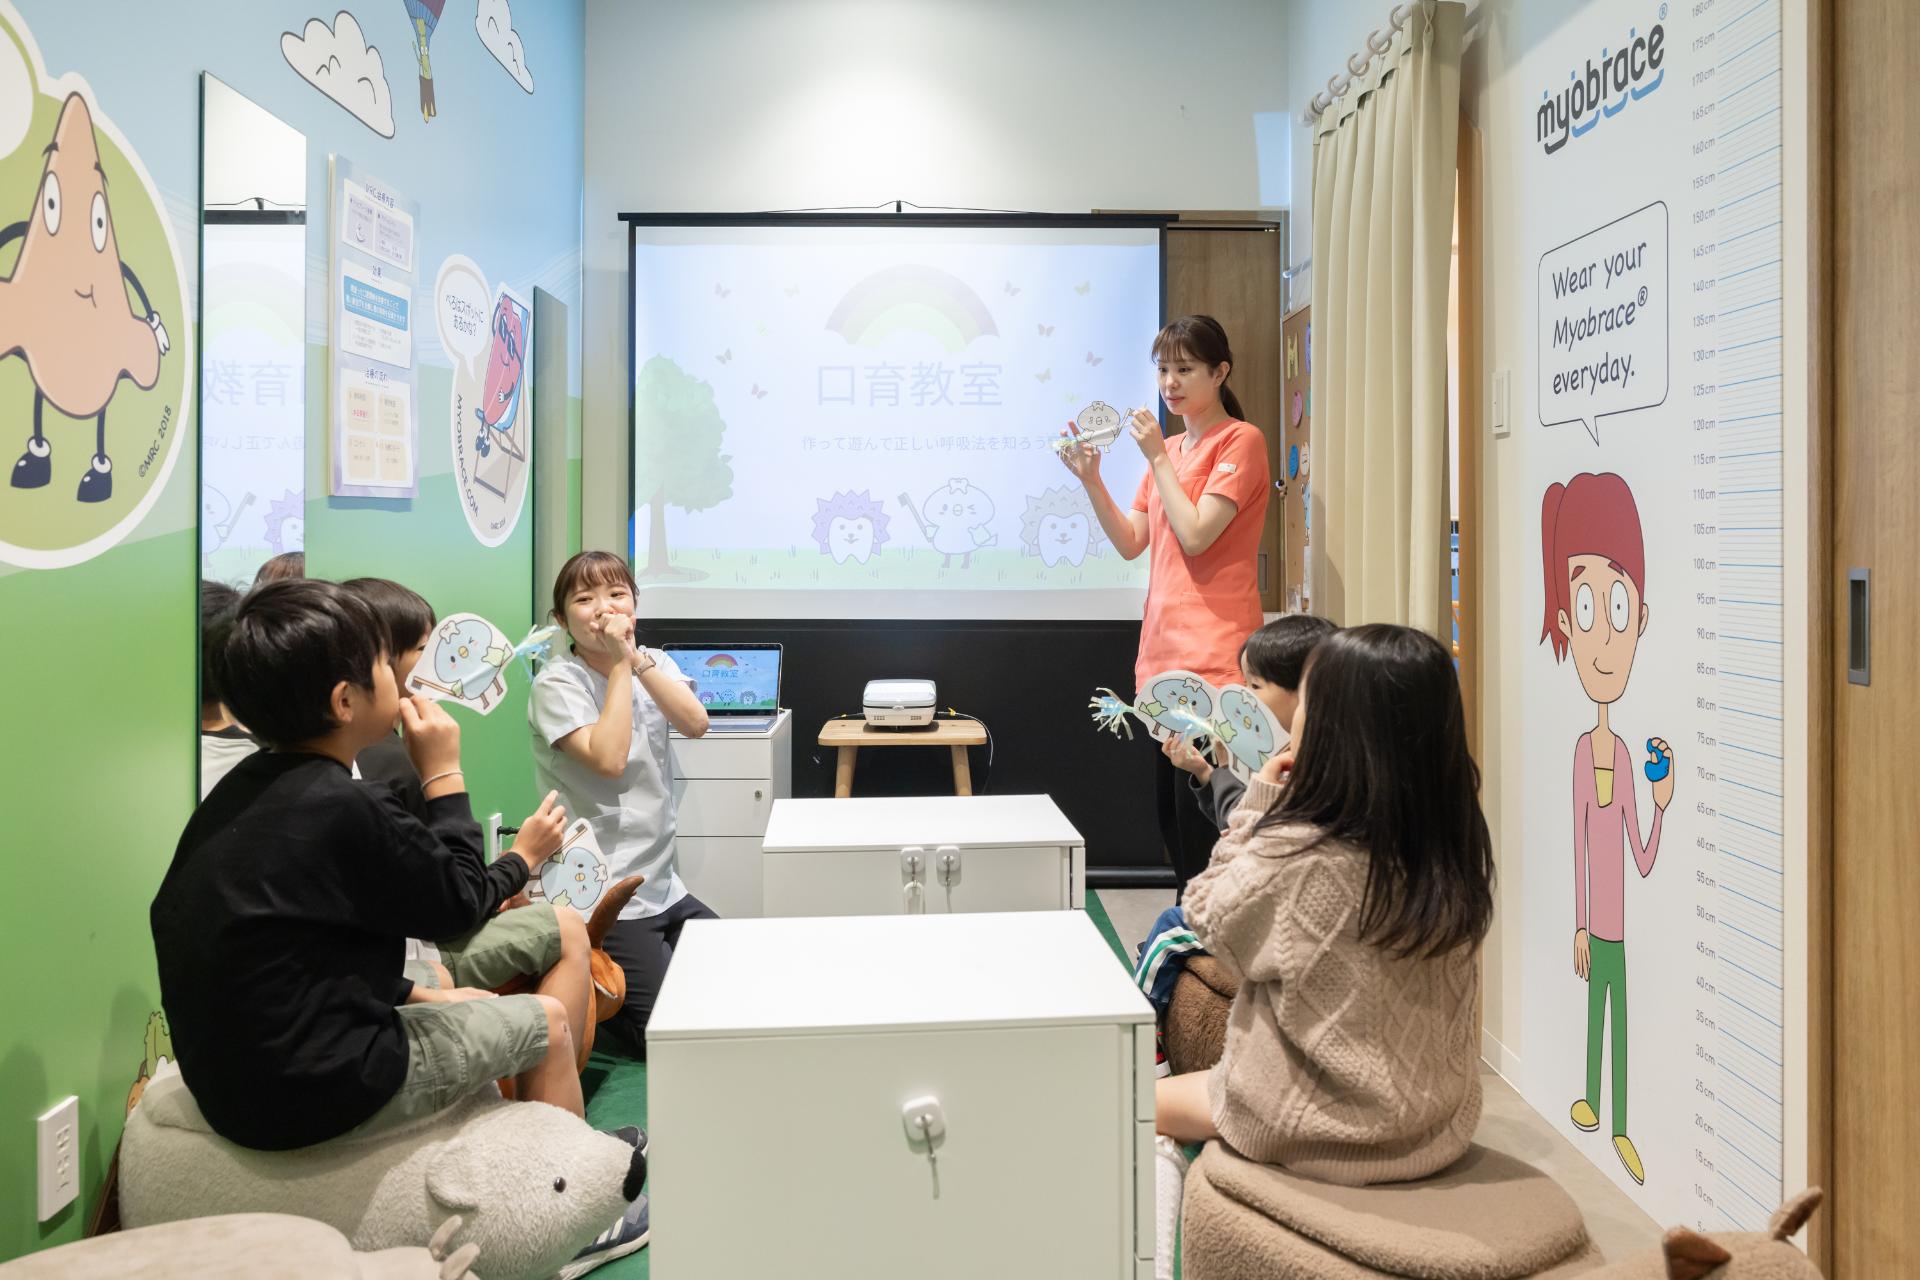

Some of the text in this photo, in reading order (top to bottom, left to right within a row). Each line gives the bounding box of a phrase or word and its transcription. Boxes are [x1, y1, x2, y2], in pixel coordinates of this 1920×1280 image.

[1552, 242, 1647, 300] Wear your
[816, 361, 1003, 407] 口育教室
[1553, 352, 1635, 395] everyday.
[138, 405, 172, 478] ©MRC 2018
